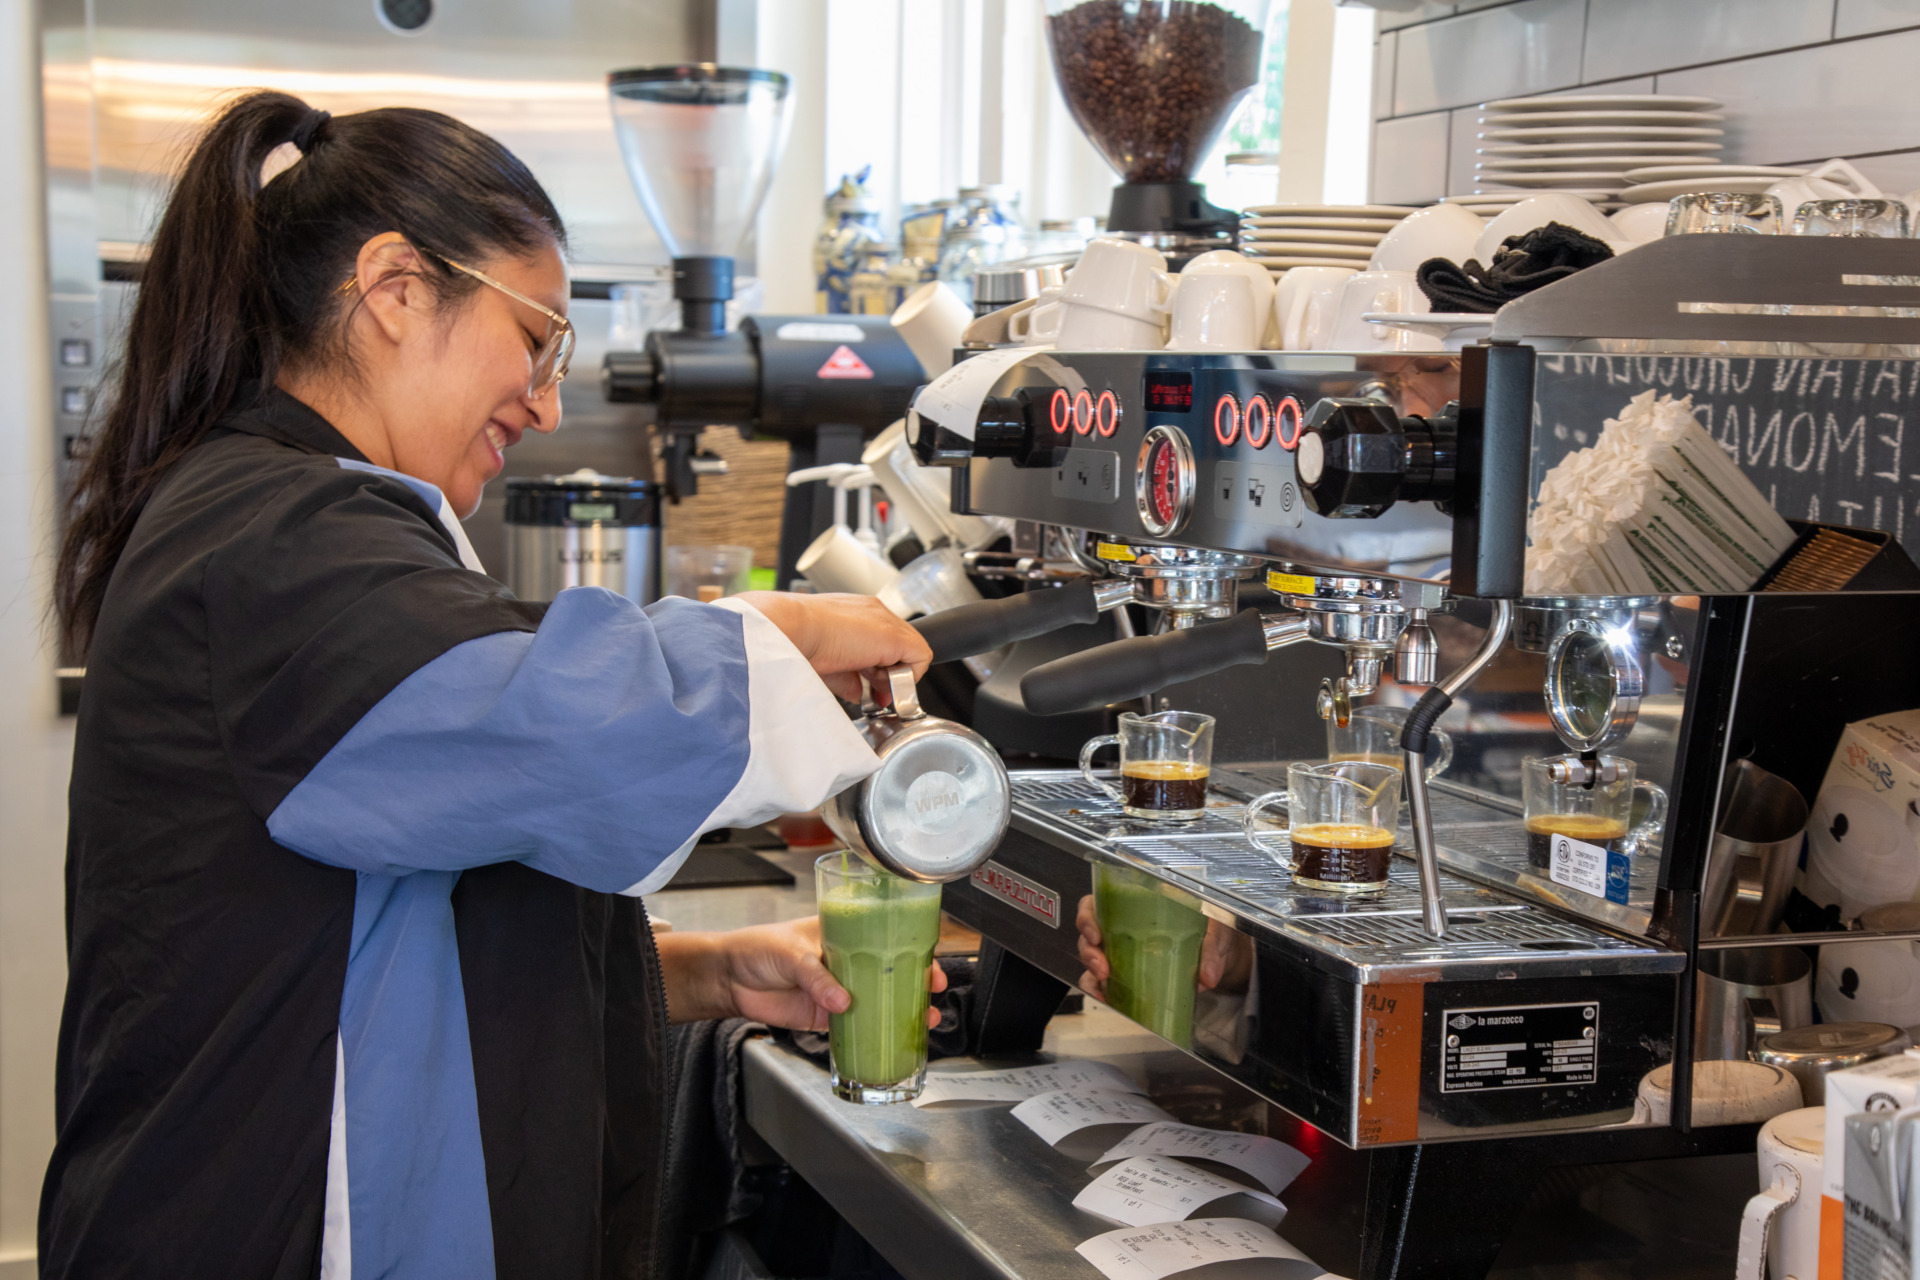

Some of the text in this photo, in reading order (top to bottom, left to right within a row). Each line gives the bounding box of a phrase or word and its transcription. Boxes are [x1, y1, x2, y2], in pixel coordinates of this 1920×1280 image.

[914, 792, 960, 813] WPM
[1478, 1015, 1524, 1026] la marzocco
